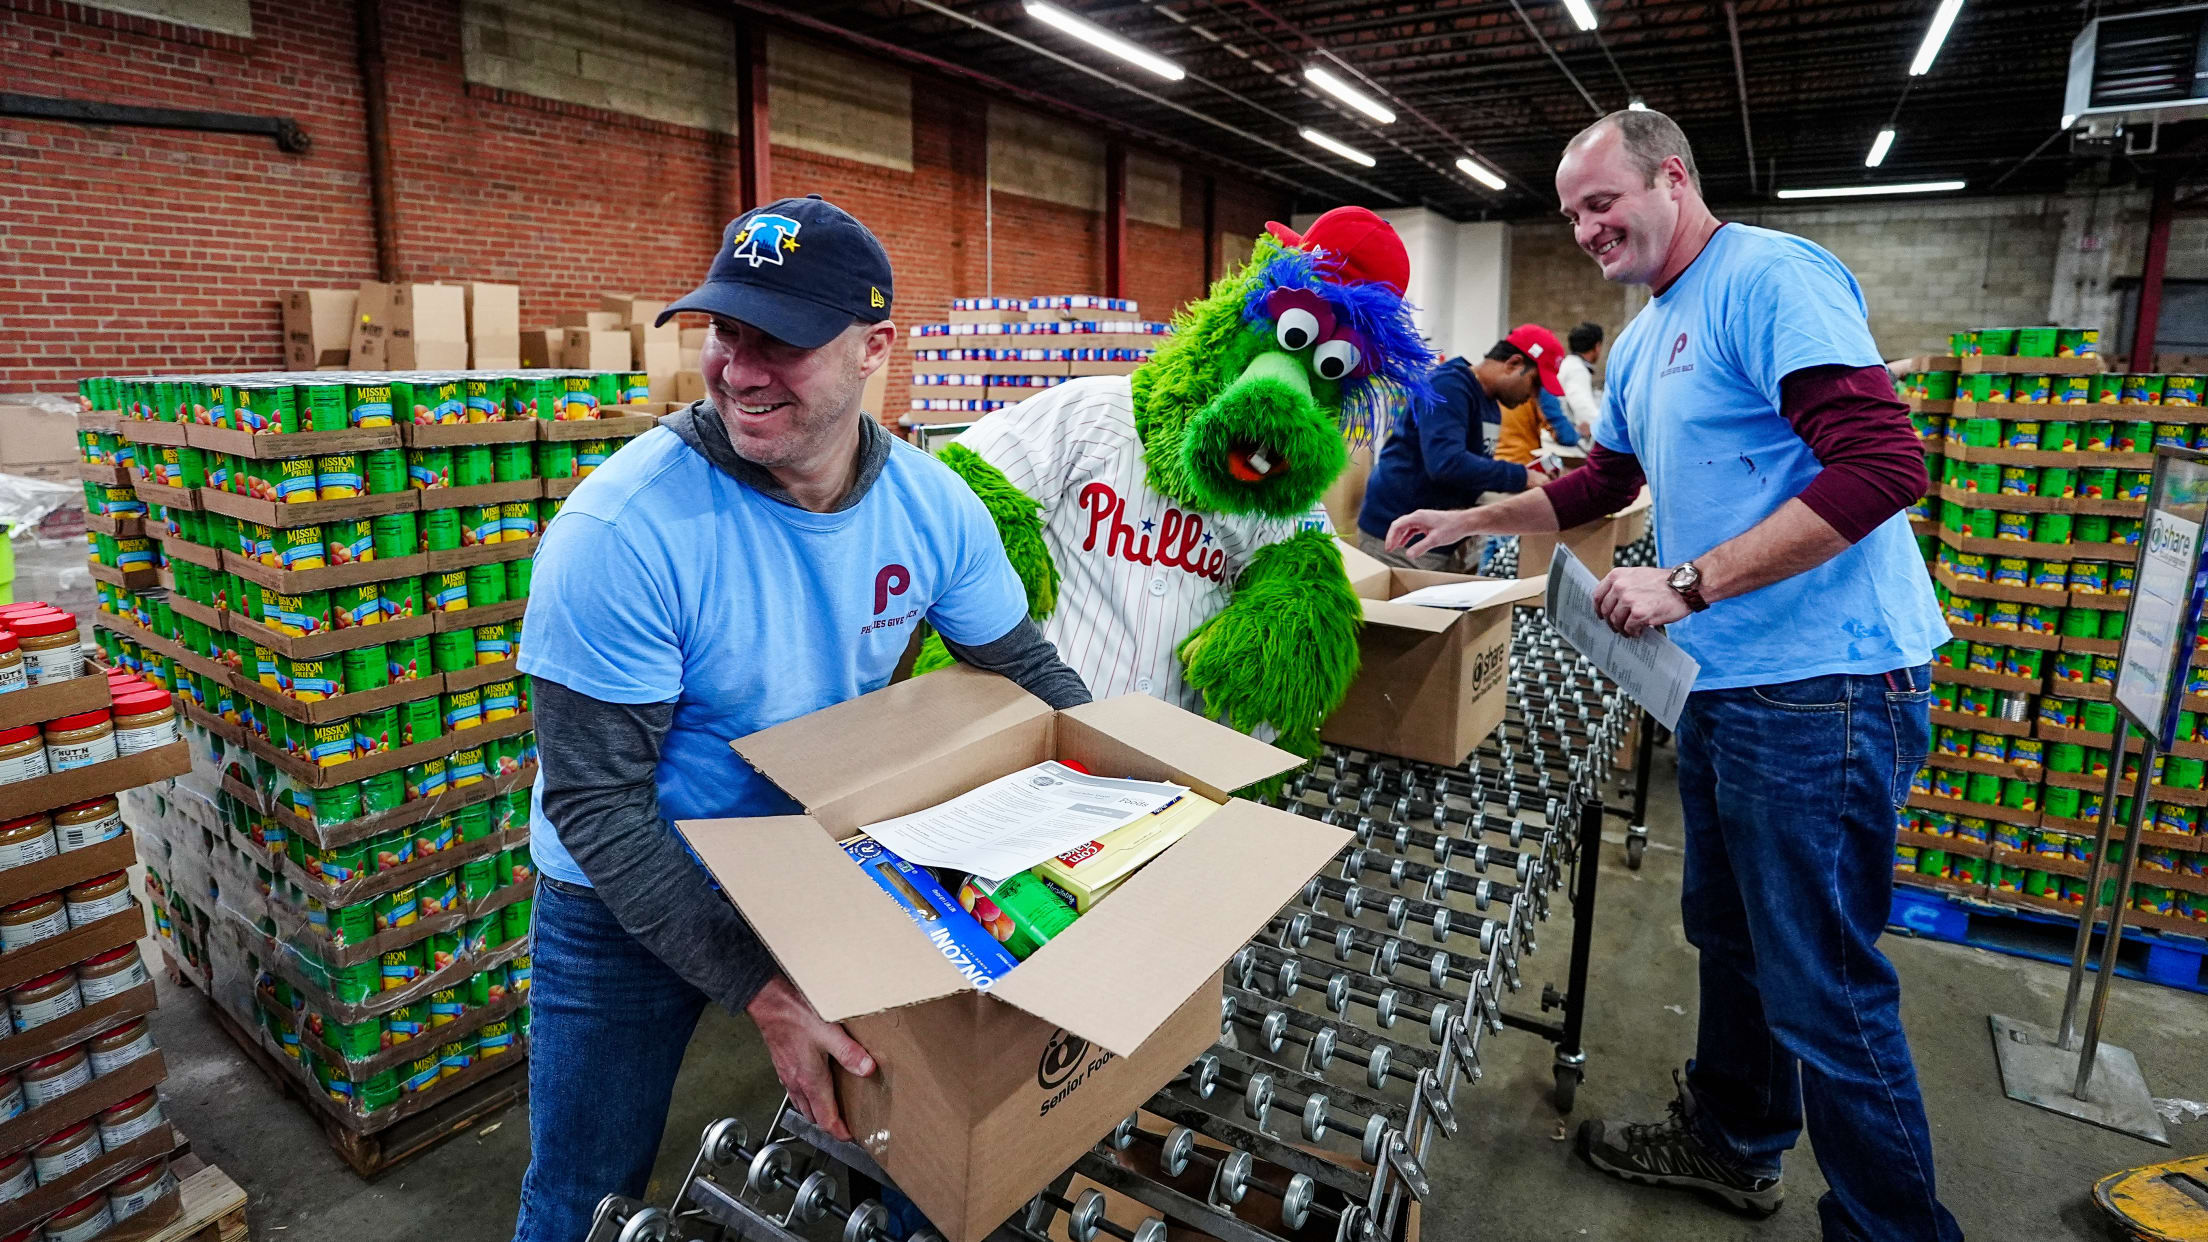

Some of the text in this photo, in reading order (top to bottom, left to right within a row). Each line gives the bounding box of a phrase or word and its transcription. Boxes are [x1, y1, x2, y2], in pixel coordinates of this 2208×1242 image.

[358, 386, 392, 401] MISSION
[366, 396, 388, 404] PRIDE
[873, 563, 911, 616] P
[860, 619, 887, 635] PHIES
[887, 616, 905, 627] GIVE
[483, 680, 515, 696] MISSION
[313, 721, 351, 742] MISSION
[321, 733, 346, 744] PRIDE
[1069, 846, 1098, 863] Corn
[930, 927, 999, 993] ONZONI
[1039, 1071, 1084, 1117] Senior
